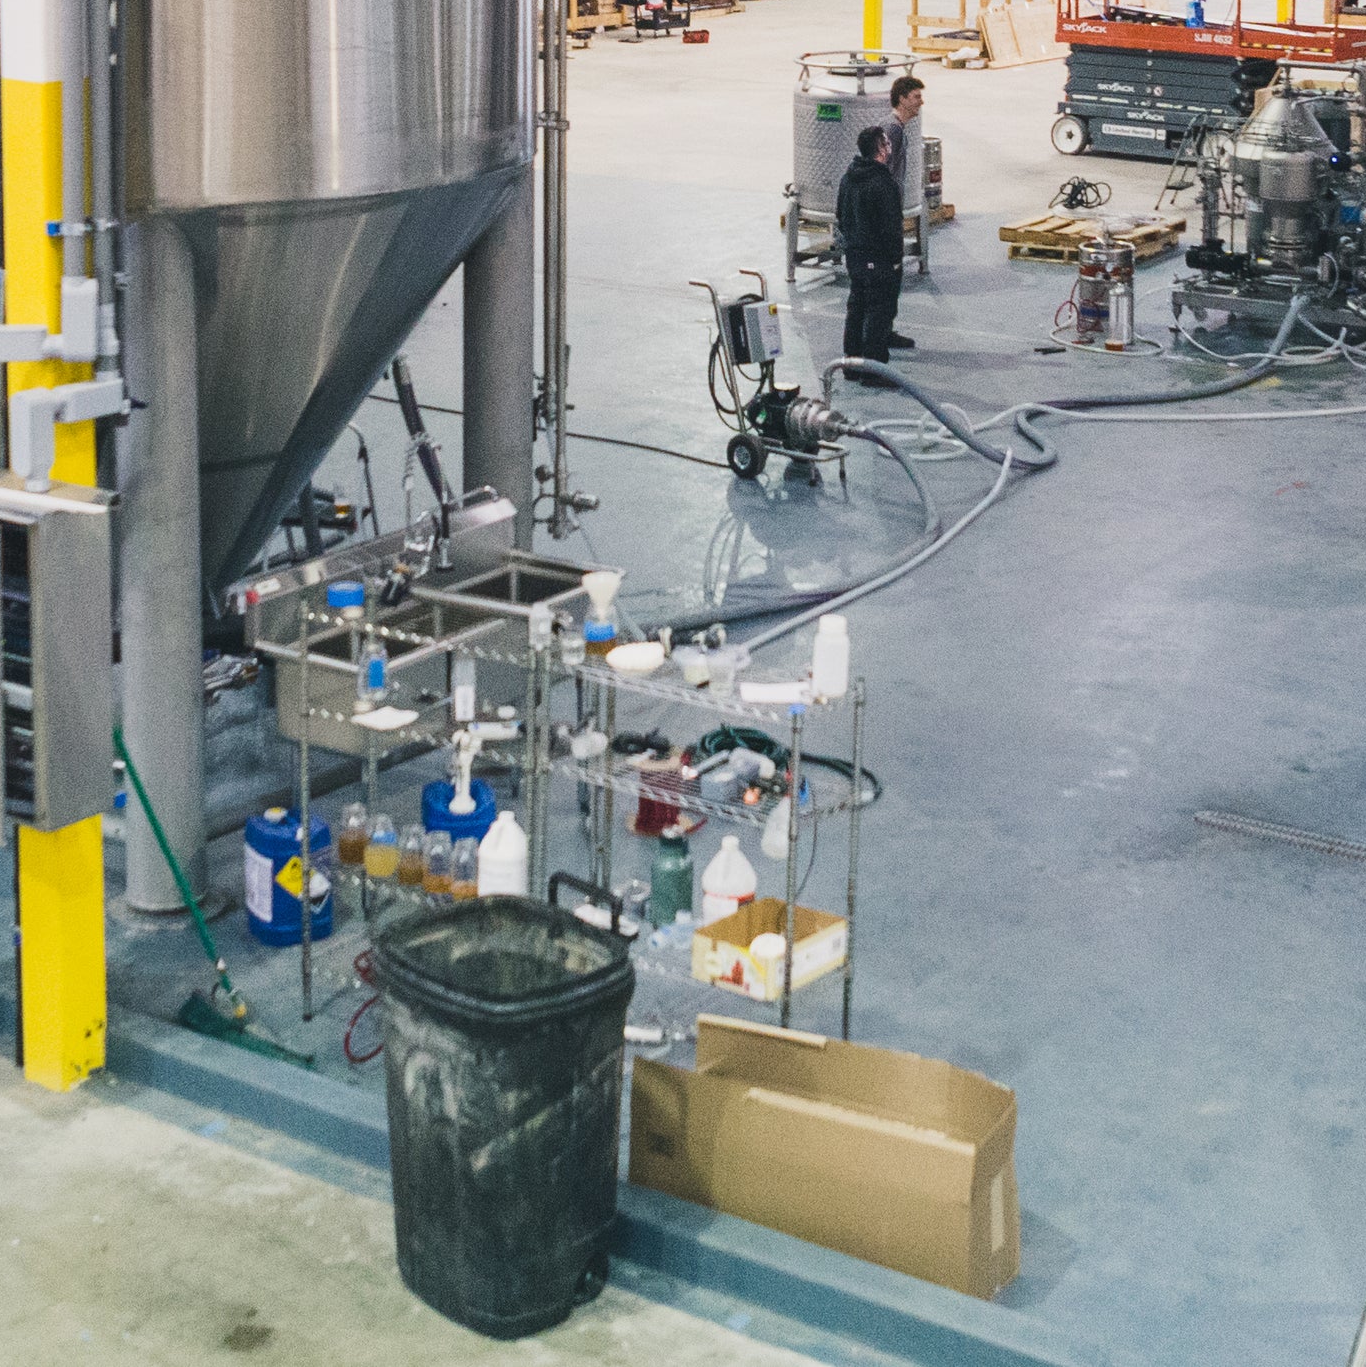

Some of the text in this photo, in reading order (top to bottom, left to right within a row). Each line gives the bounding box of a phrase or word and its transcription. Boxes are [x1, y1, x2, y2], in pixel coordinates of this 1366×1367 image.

[1062, 22, 1107, 34] SKYJACK
[1097, 82, 1135, 93] SKYJACK
[1127, 110, 1165, 122] SKYJACK
